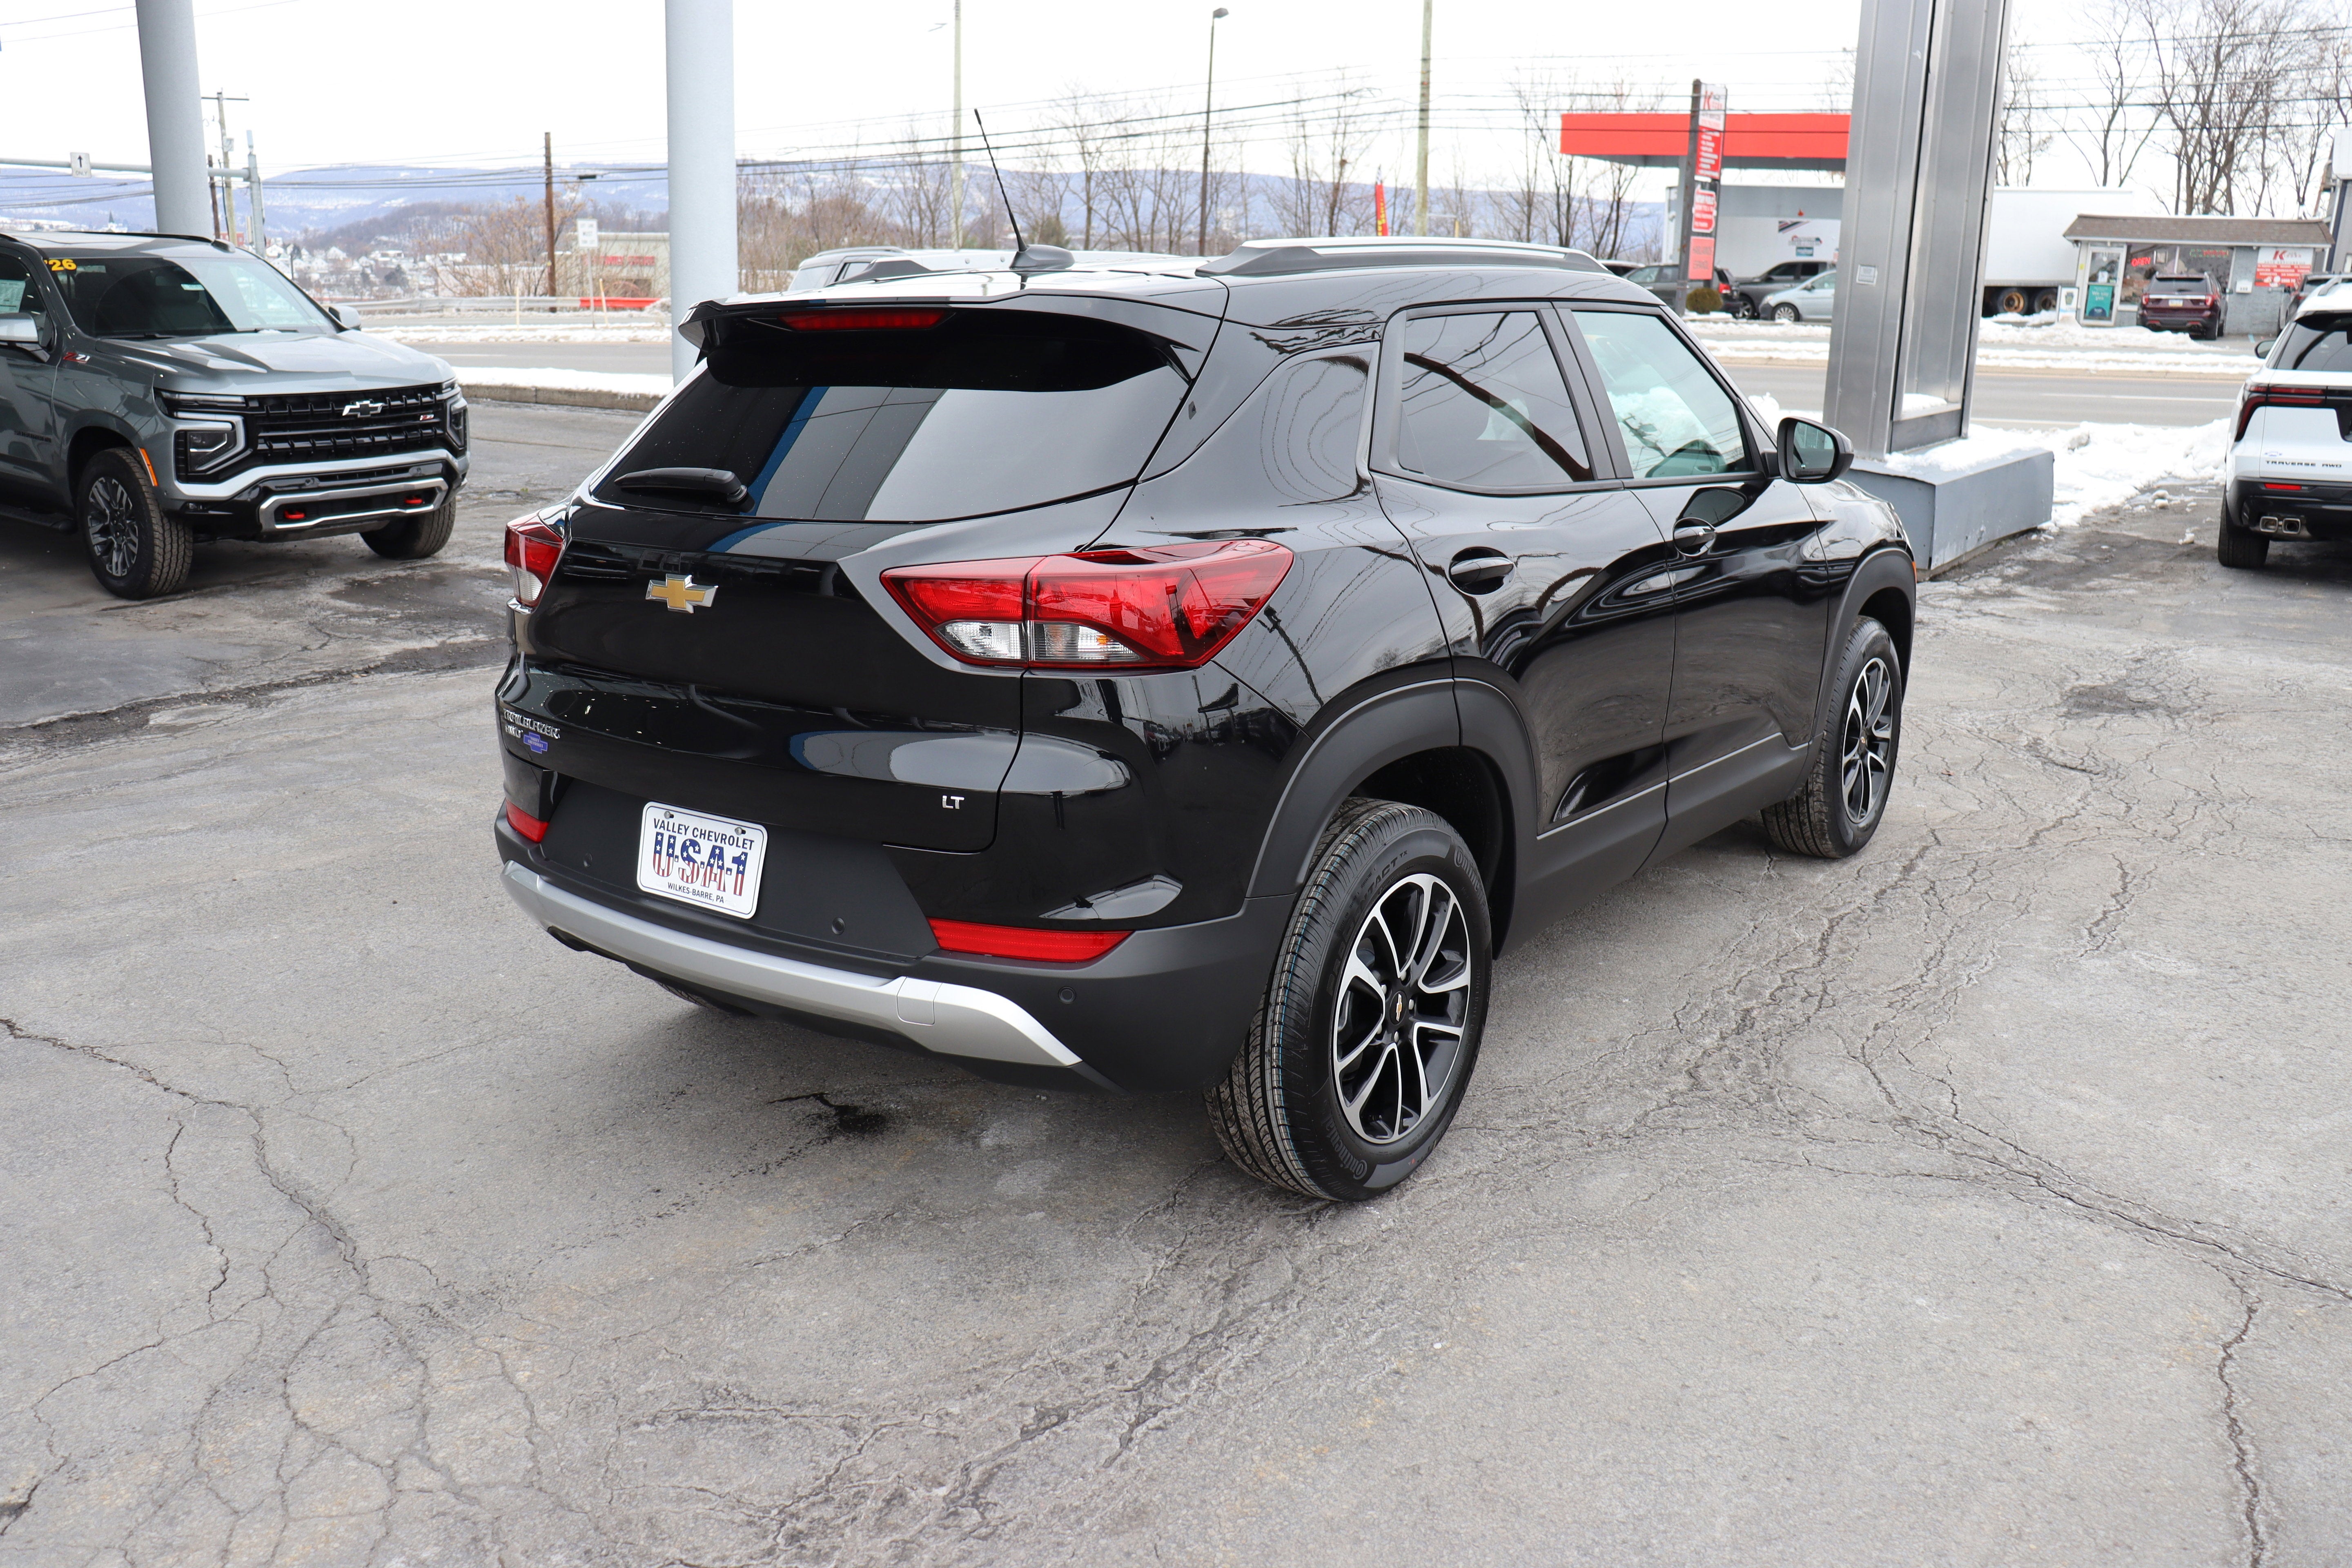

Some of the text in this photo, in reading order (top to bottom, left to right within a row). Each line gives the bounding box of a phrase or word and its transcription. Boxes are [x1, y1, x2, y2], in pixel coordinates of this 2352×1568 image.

[2131, 257, 2151, 267] OPEN
[63, 352, 91, 363] Z71
[503, 708, 561, 739] TRAILBLAZER
[505, 724, 523, 739] AWD
[942, 795, 965, 809] LT
[654, 818, 755, 851] VALLEY CHEVROLET
[668, 882, 724, 903] WILKES-BARRE, PA
